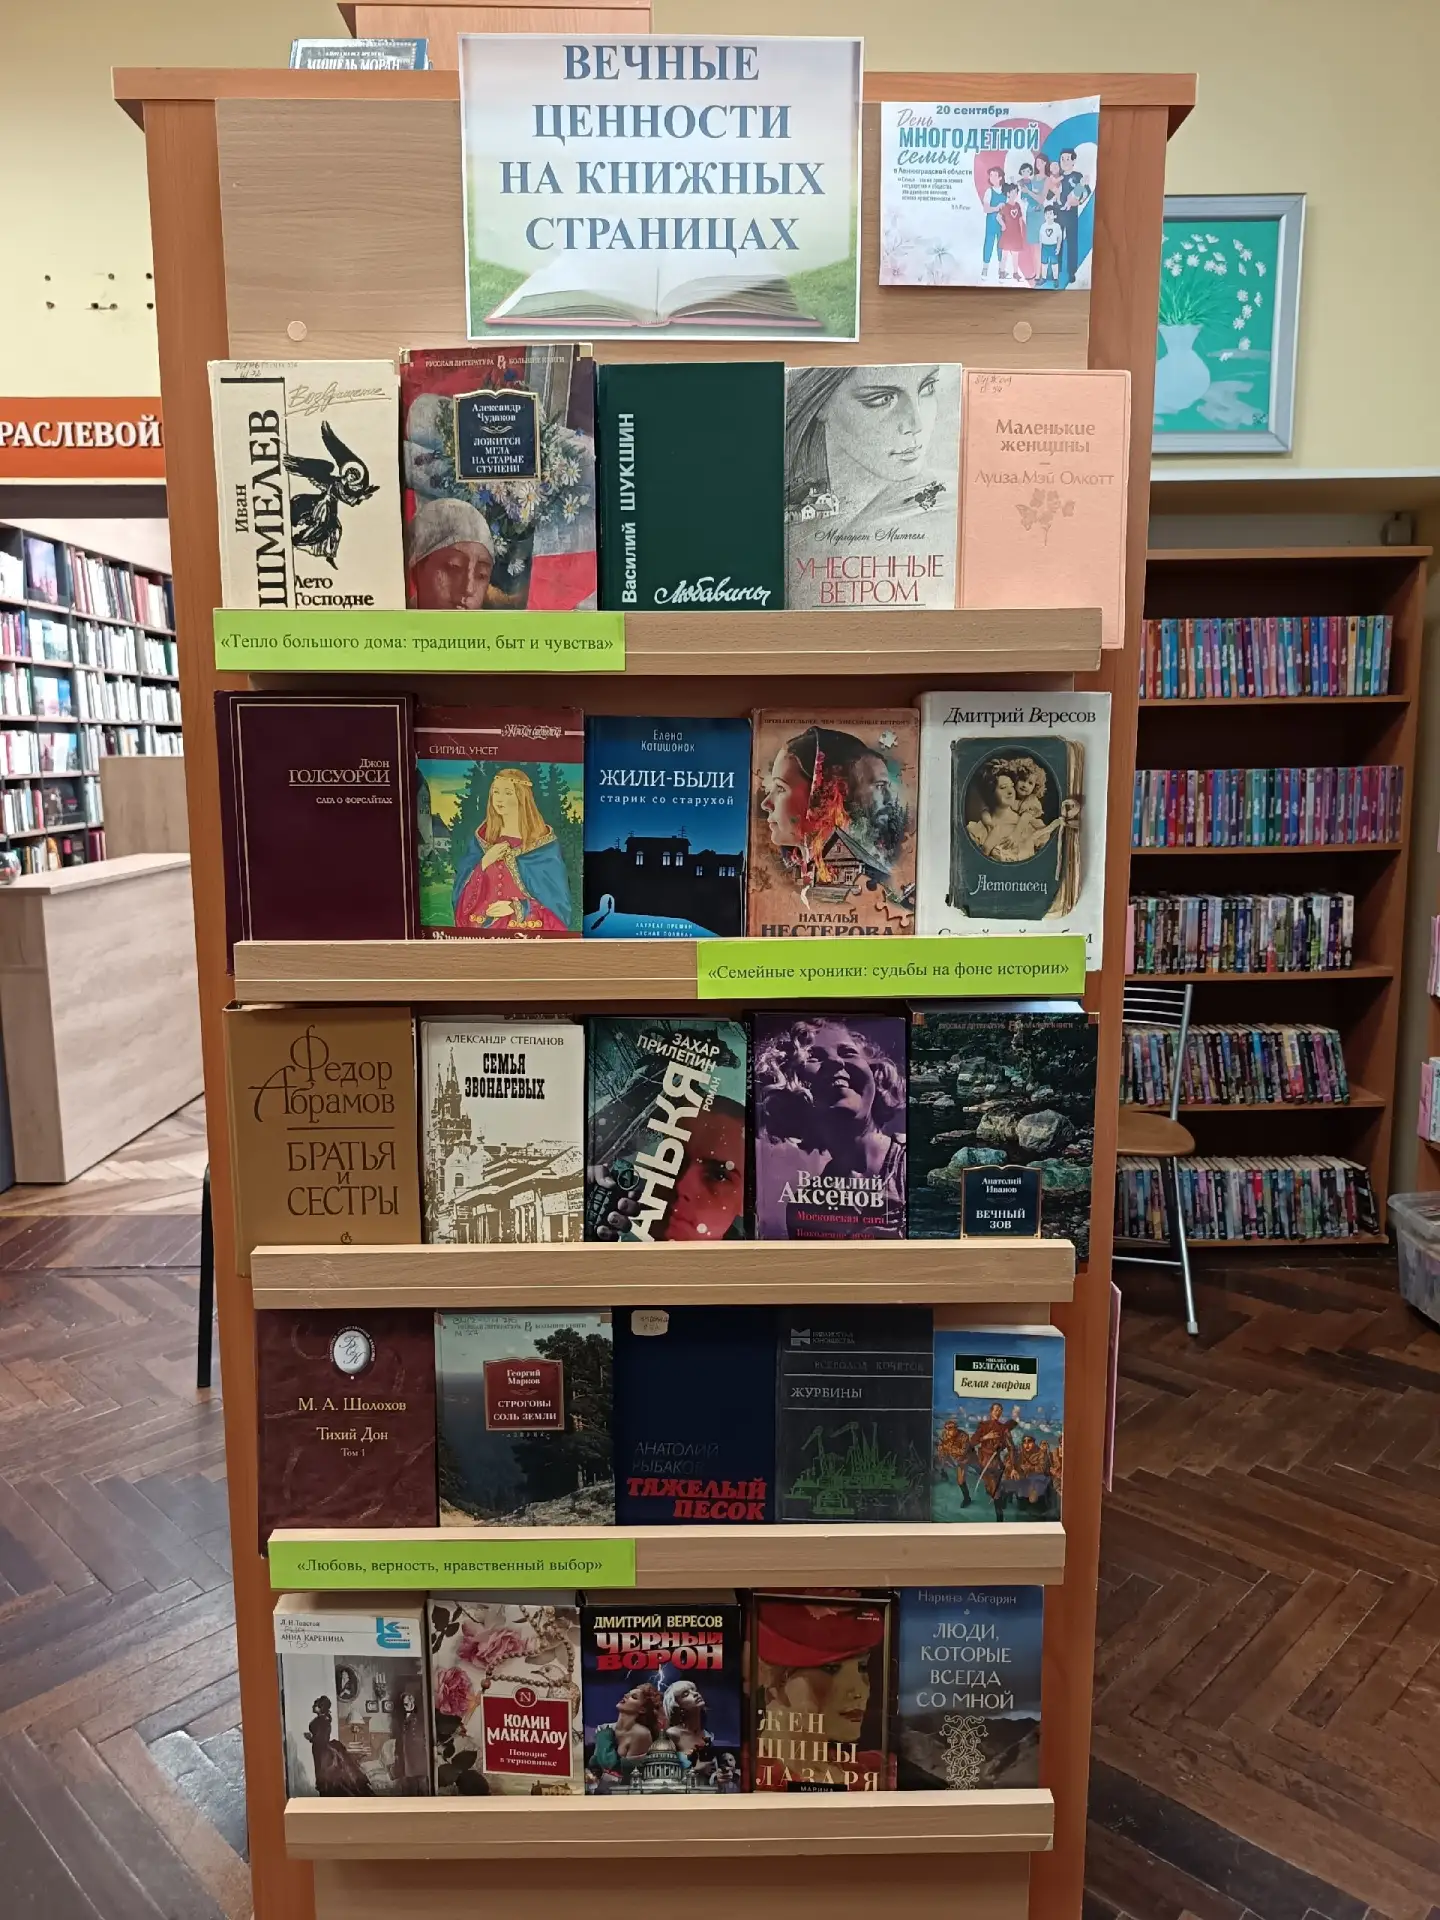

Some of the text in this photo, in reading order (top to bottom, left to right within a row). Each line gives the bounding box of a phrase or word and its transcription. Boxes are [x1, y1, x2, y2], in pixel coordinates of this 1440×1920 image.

[563, 44, 759, 81] ВЕЧНЫЕ
[898, 108, 933, 127] День
[936, 105, 1010, 116] 20 сентября
[532, 104, 792, 145] ЦЕННОСТИ
[899, 122, 1040, 153] МНОГОДЕТНОЙ
[499, 161, 826, 195] НА КНИЖНЫХ
[526, 217, 799, 257] СТРАНИЦАХ
[472, 404, 521, 413] Александр
[477, 413, 516, 423] Чудаков
[0, 414, 163, 448] РАСЛЕВОЙ
[995, 419, 1096, 436] Маленькие
[473, 437, 521, 446] ЛОЖИТСЯ
[1000, 440, 1090, 456] женщины
[485, 447, 510, 455] МГЛА
[472, 456, 524, 464] НА СТАРЫЕ
[476, 464, 520, 473] СТУПЕНИ
[974, 470, 1018, 487] Луиза
[1022, 470, 1055, 484] Мэй
[235, 484, 249, 533] Иван
[248, 409, 288, 608] ШМЕЛЕВ
[618, 413, 637, 603] Василий ШУКШИН
[796, 555, 944, 579] УНЕСЕННЫЕ
[654, 576, 771, 607] Любавины
[820, 580, 919, 604] ВЕТРОМ
[220, 633, 613, 653] «Тепло большого дома: традиции, быт и чувства»
[943, 707, 1097, 728] Дмитрий Вересов
[653, 728, 683, 741] Елена
[429, 745, 499, 756] СИГРИД УНСЕТ
[359, 759, 390, 770] Джон
[288, 769, 390, 784] ГОЛСУОРСИ
[599, 769, 734, 789] ЖИЛИ-БЫЛИ
[344, 795, 392, 804] ФОРСАЙТАХ
[600, 793, 734, 807] старик со старухой
[969, 875, 1048, 895] Летописец
[799, 914, 858, 923] НАТАЛЬЯ
[761, 924, 893, 936] НЕСТЕРОВА
[708, 962, 1069, 981] «Семейные хроники: судьбы на фоне истории»
[445, 1034, 564, 1046] АЛЕКСАНДР СТЕПАНОВ
[672, 1033, 720, 1058] ЗАХАР
[290, 1024, 393, 1089] Федор
[636, 1034, 717, 1073] ПРИЛЕПИН
[483, 1053, 526, 1075] СЕМЬЯ
[248, 1066, 395, 1123] Абрамов
[465, 1076, 545, 1100] ЗВОНАРЕВЫХ
[703, 1076, 721, 1112] РОМАН
[286, 1142, 396, 1171] БРАТЬЯ
[797, 1170, 883, 1191] Василий
[982, 1177, 1022, 1185] Анатолий
[986, 1185, 1017, 1194] Иванов
[287, 1185, 399, 1216] СЕСТРЫ
[796, 1210, 885, 1225] Московская сага
[976, 1208, 1026, 1219] ВЕЧНЫЙ
[989, 1220, 1012, 1229] ЗОВ
[507, 1369, 541, 1379] Георгий
[972, 1362, 1020, 1371] БУЛГАКОВ
[508, 1377, 541, 1387] Марков
[960, 1377, 1031, 1392] Белая гвардия
[790, 1387, 862, 1399] ЖУРБИНЫ
[298, 1398, 407, 1411] М. А. Шолохов
[497, 1400, 551, 1408] СТРОГОВЫ
[493, 1413, 557, 1421] СОЛЬ ЗЕМЛИ
[316, 1426, 388, 1442] Тихий Дон
[341, 1447, 359, 1457] Том
[635, 1442, 719, 1457] АНАТОЛИЙ
[627, 1476, 767, 1500] ТЯЖЕЛЫЙ
[672, 1499, 766, 1520] ПЕСОК
[297, 1558, 603, 1574] «Любовь, верность, нравственный выбор»
[918, 1590, 1017, 1606] Наринэ Абгарян
[593, 1614, 723, 1629] ДМИТРИЙ ВЕРЕСОВ
[304, 1634, 345, 1643] КАРЕНИНА
[932, 1623, 1000, 1642] ЛЮДИ,
[594, 1631, 724, 1655] ЧЕРНЫЙ
[596, 1644, 724, 1671] ВОРОН
[921, 1646, 1012, 1663] КОТОРЫЕ
[930, 1669, 1002, 1689] ВСЕГДА
[916, 1690, 1014, 1710] СО МНОЙ
[503, 1714, 550, 1730] КОЛИН
[756, 1709, 826, 1734] ЖЕН
[487, 1727, 568, 1750] МАККАЛОУ
[509, 1748, 547, 1760] Поющие
[757, 1738, 859, 1764] ЩИНЫ
[506, 1757, 557, 1767] терновнике
[755, 1764, 880, 1791] ЛАЗАРЯ
